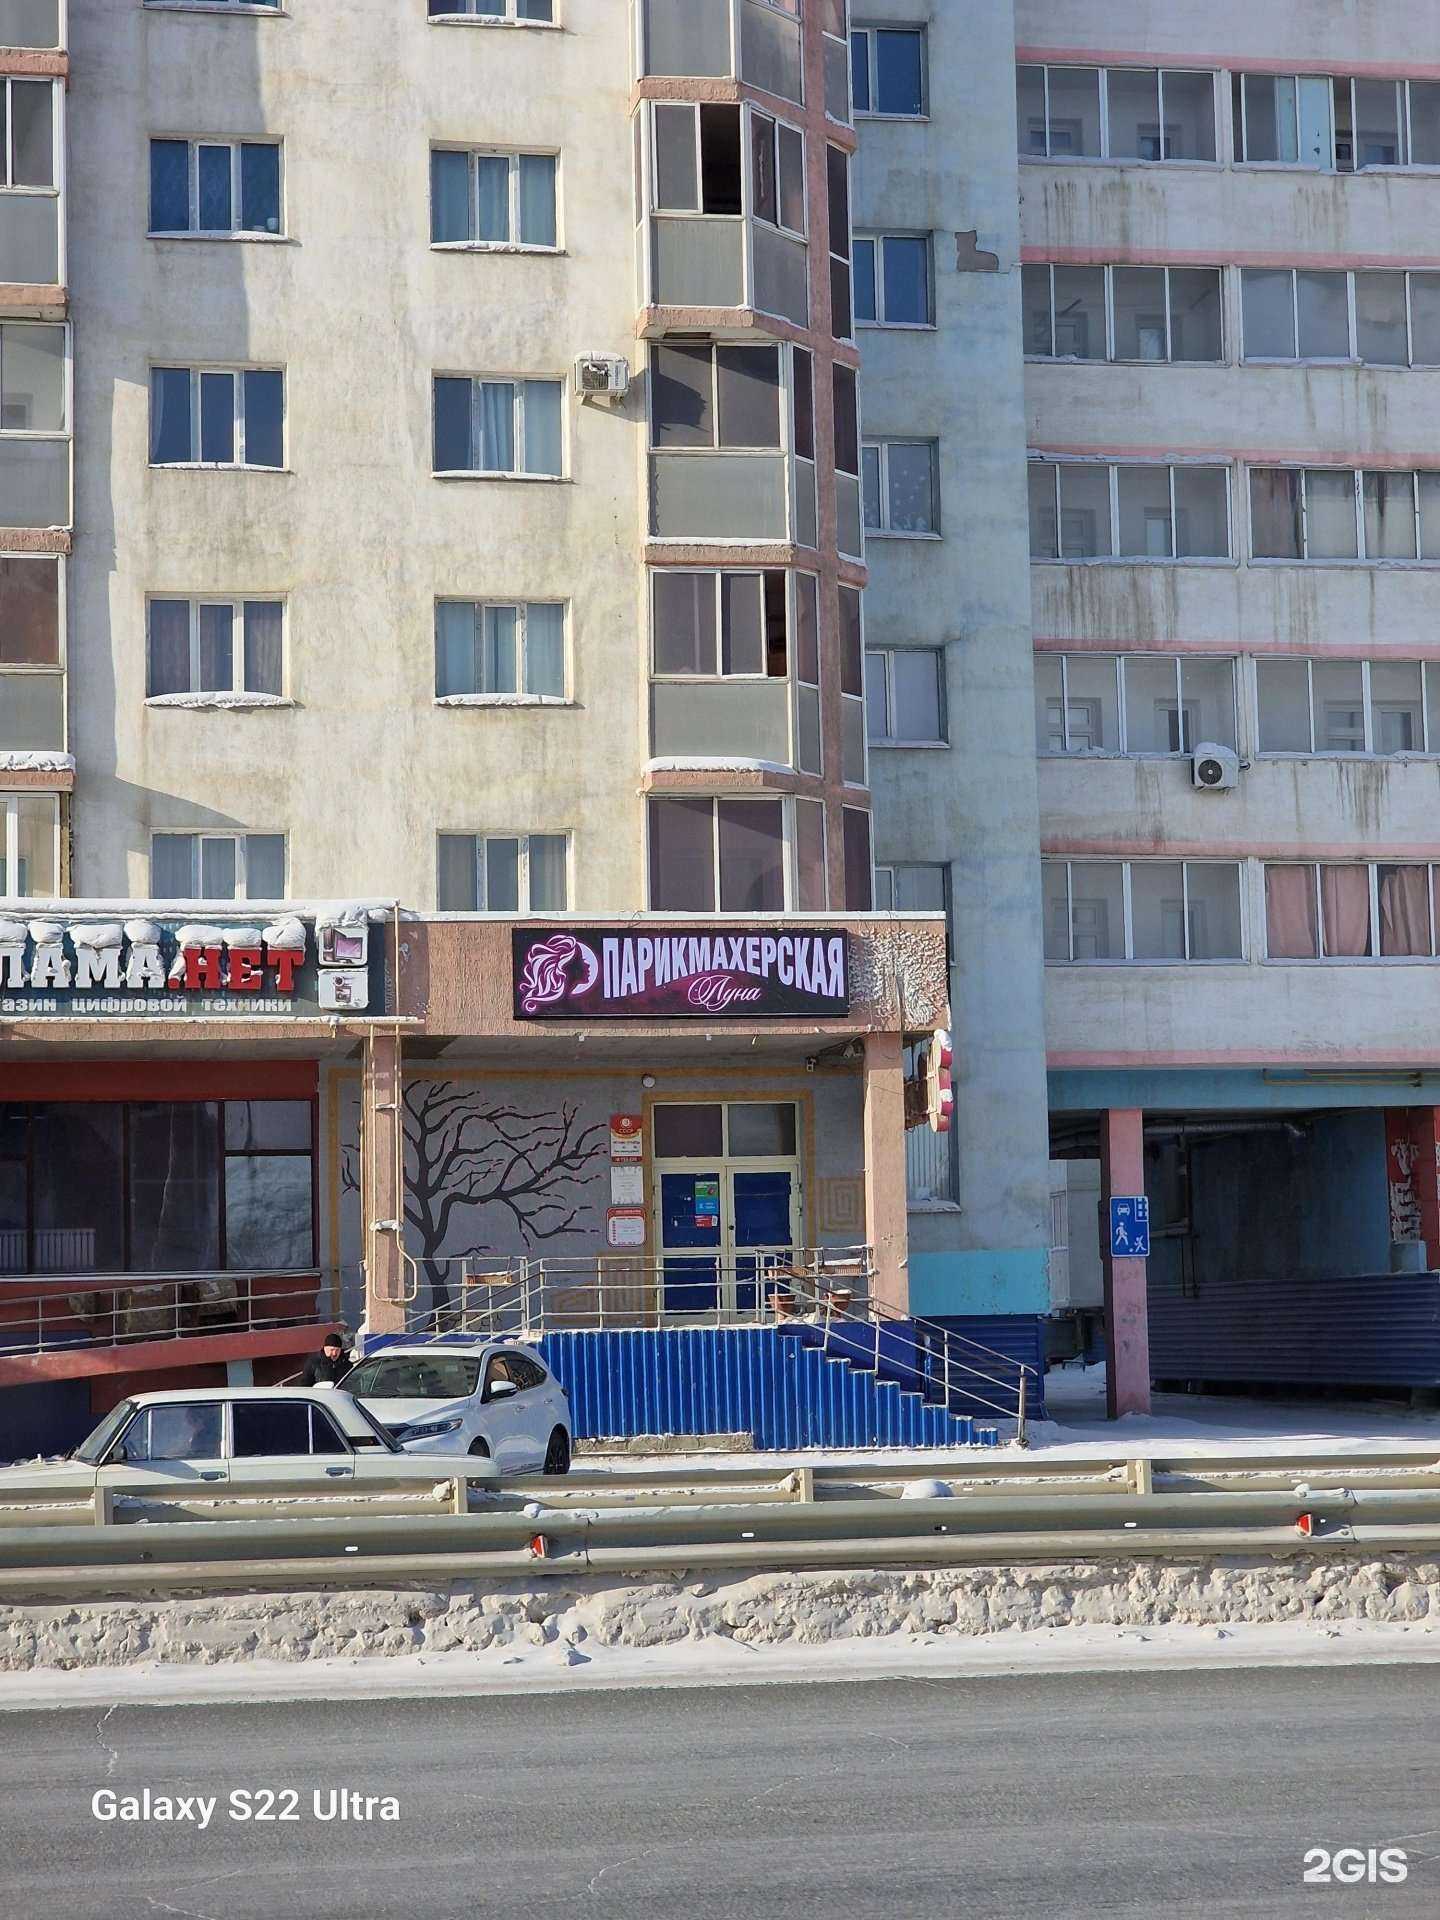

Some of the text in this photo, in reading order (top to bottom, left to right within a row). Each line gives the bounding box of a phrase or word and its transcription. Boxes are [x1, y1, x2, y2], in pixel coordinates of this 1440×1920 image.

[602, 936, 846, 999] ПАРИКМАХЕРСКАЯ
[71, 994, 187, 1015] цифровой
[202, 998, 292, 1013] техники
[687, 974, 761, 1012] Луна
